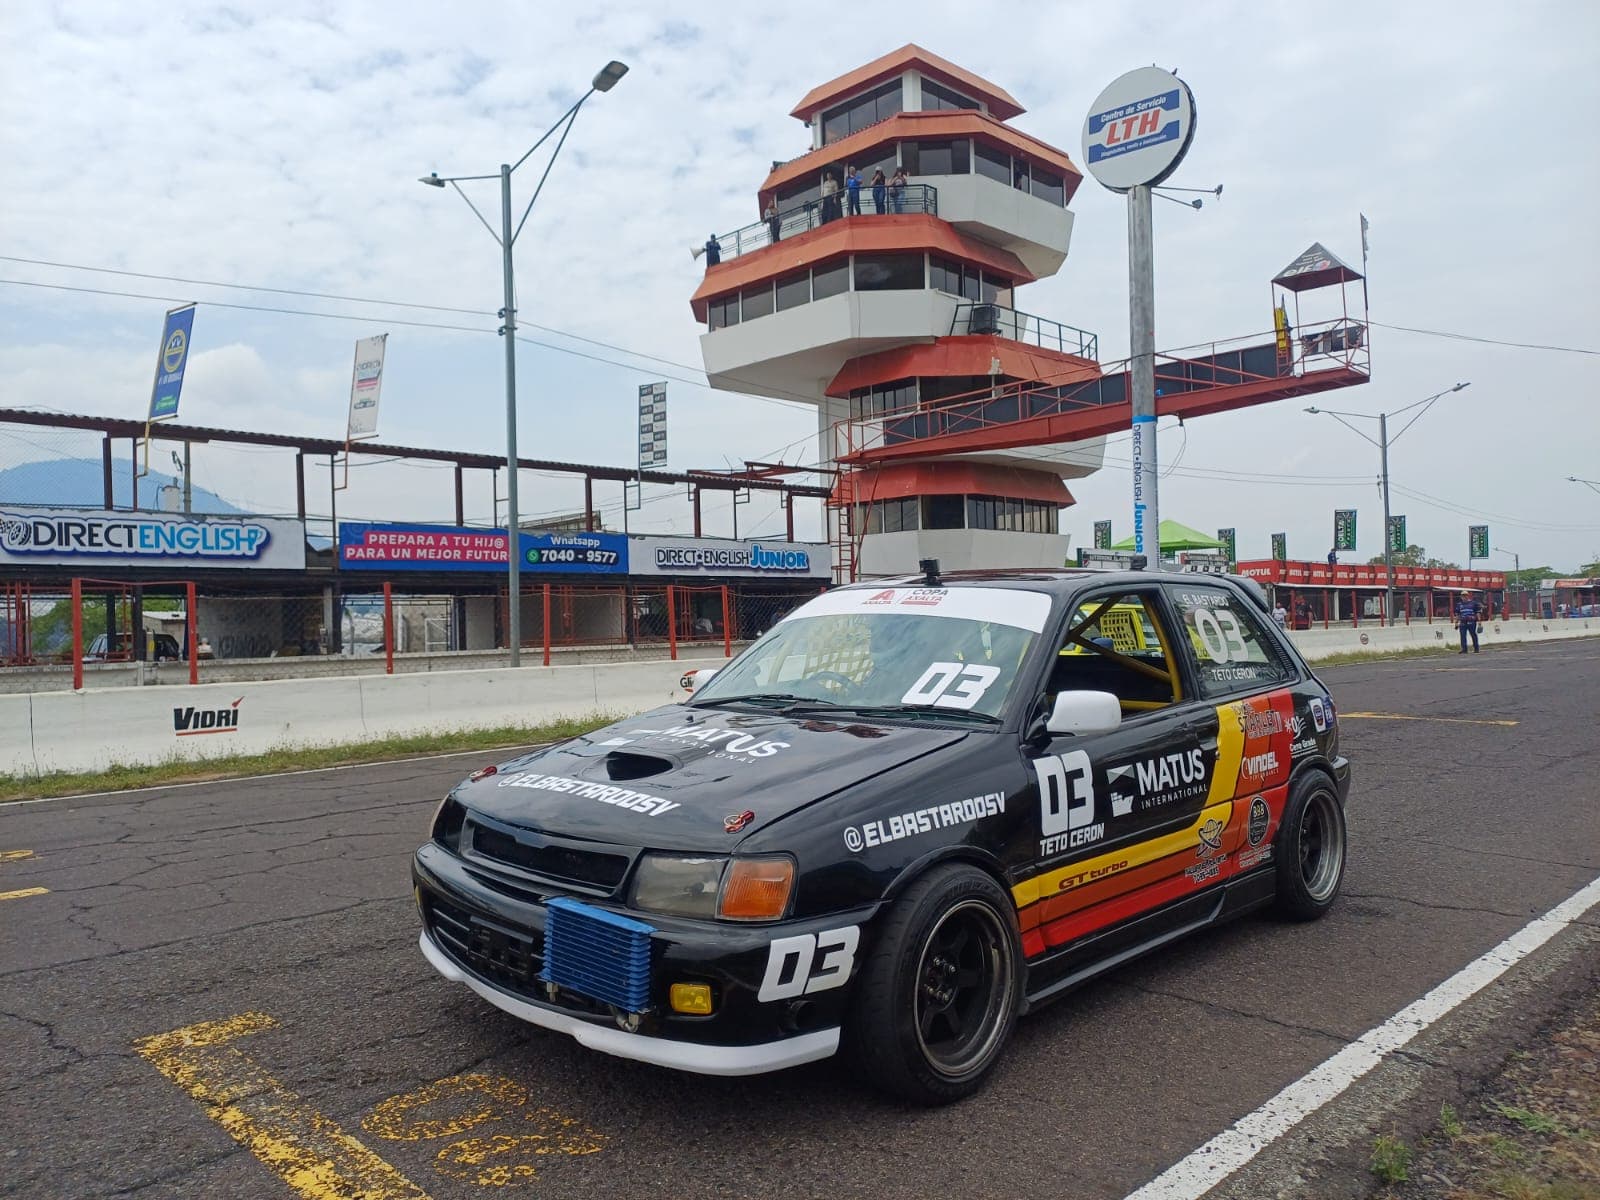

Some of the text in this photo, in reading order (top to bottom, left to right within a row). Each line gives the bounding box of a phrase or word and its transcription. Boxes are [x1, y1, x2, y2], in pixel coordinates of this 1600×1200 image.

[1136, 96, 1167, 112] Servicio
[1106, 109, 1161, 146] LTH
[368, 534, 505, 549] PREPARA A TU HIJ@
[1134, 502, 1147, 554] JUNIOR
[346, 548, 509, 561] PARA UN MEJOR FUTUR
[541, 549, 575, 562] 7040
[586, 550, 617, 563] 9577
[751, 544, 808, 568] JUNIOR
[1241, 568, 1271, 578] MOTUL
[1195, 608, 1249, 665] 03
[901, 661, 1001, 710] 03
[1211, 666, 1257, 681] TETO CERON
[661, 726, 791, 757] MATUS
[1136, 748, 1206, 797] MATUS
[1033, 749, 1095, 837] 03
[1141, 784, 1208, 810] INTERNATIONAL
[844, 791, 1006, 853] @ELBASTARDOSV
[1039, 822, 1105, 857] TETO CERON
[1059, 860, 1129, 890] GT turbo
[757, 924, 861, 1003] 03
